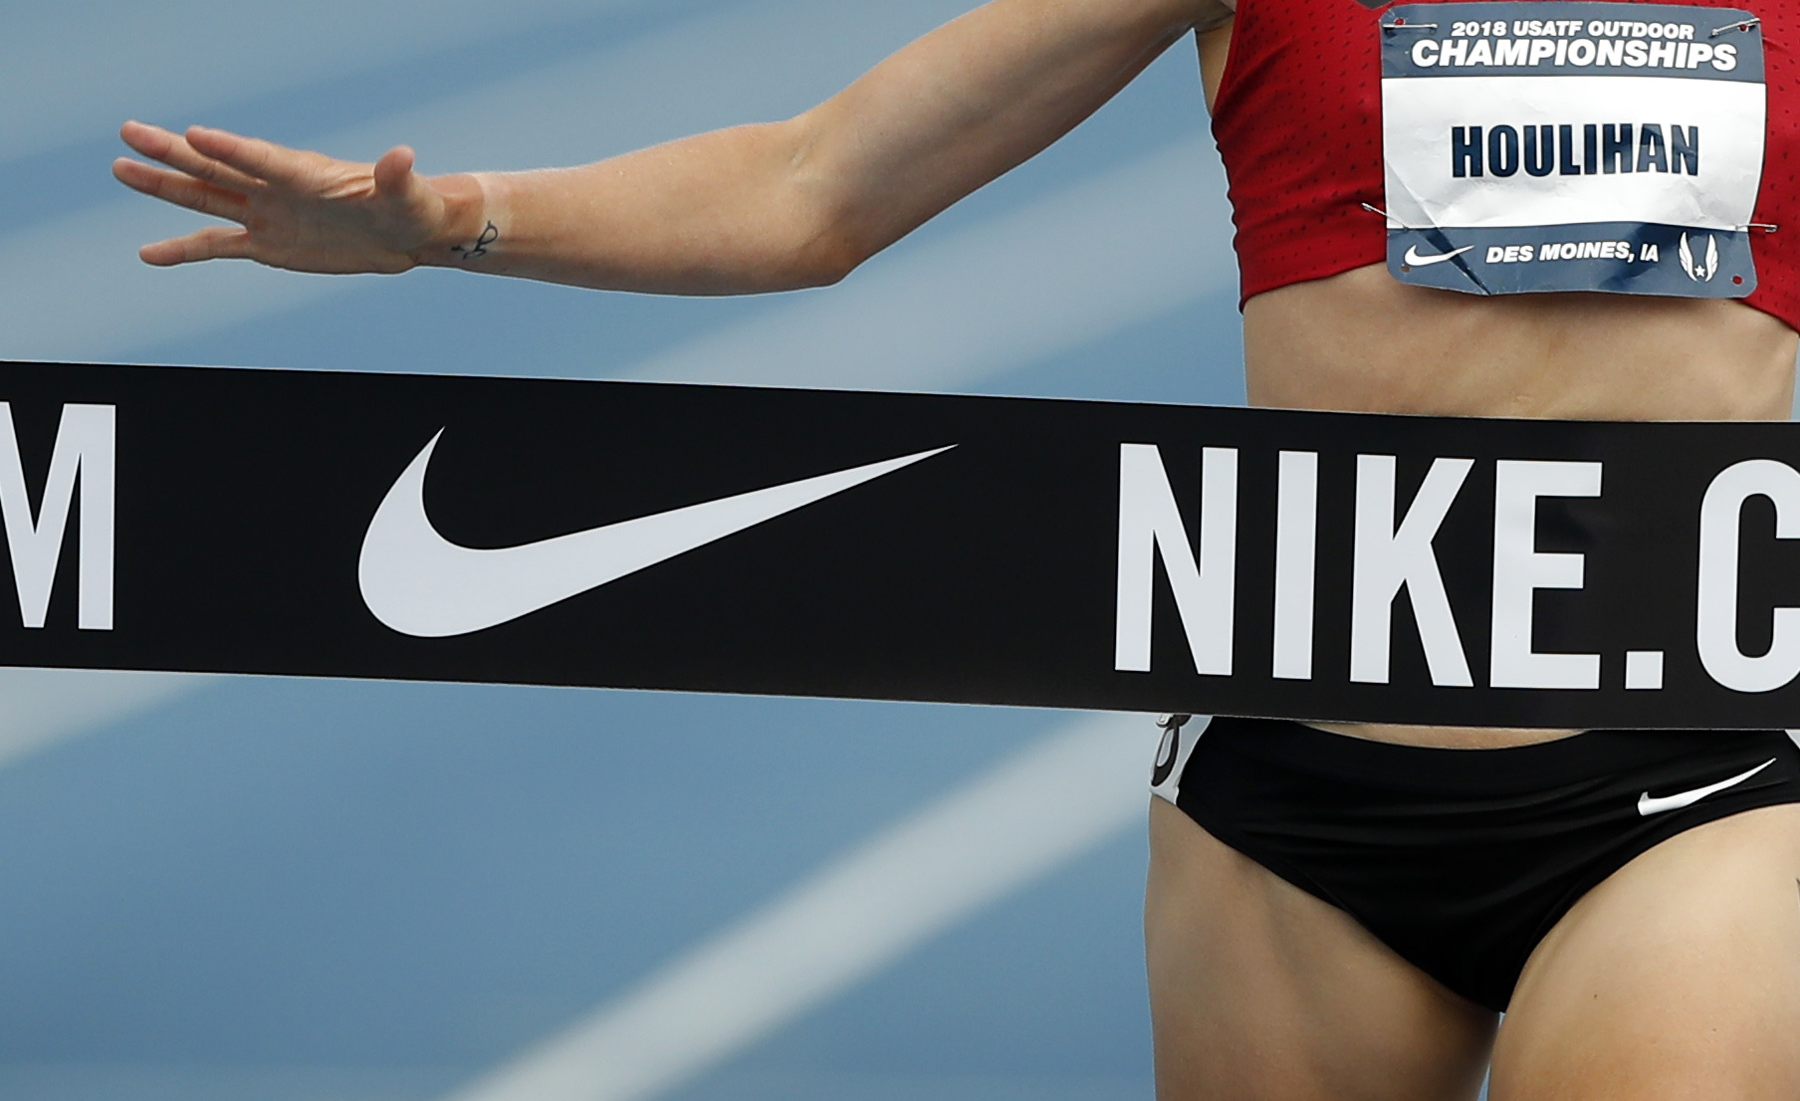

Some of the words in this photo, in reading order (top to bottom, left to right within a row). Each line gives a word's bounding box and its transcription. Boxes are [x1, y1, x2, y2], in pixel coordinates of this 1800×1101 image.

[1451, 21, 1507, 37] 2018
[1513, 21, 1584, 37] USATF
[1588, 20, 1695, 40] OUTDOOR
[1411, 39, 1738, 72] CHAMPIONSHIPS
[1451, 123, 1700, 178] HOULIHAN
[1486, 246, 1533, 264] DES
[1539, 242, 1636, 262] MOINES,
[1640, 244, 1659, 262] IA
